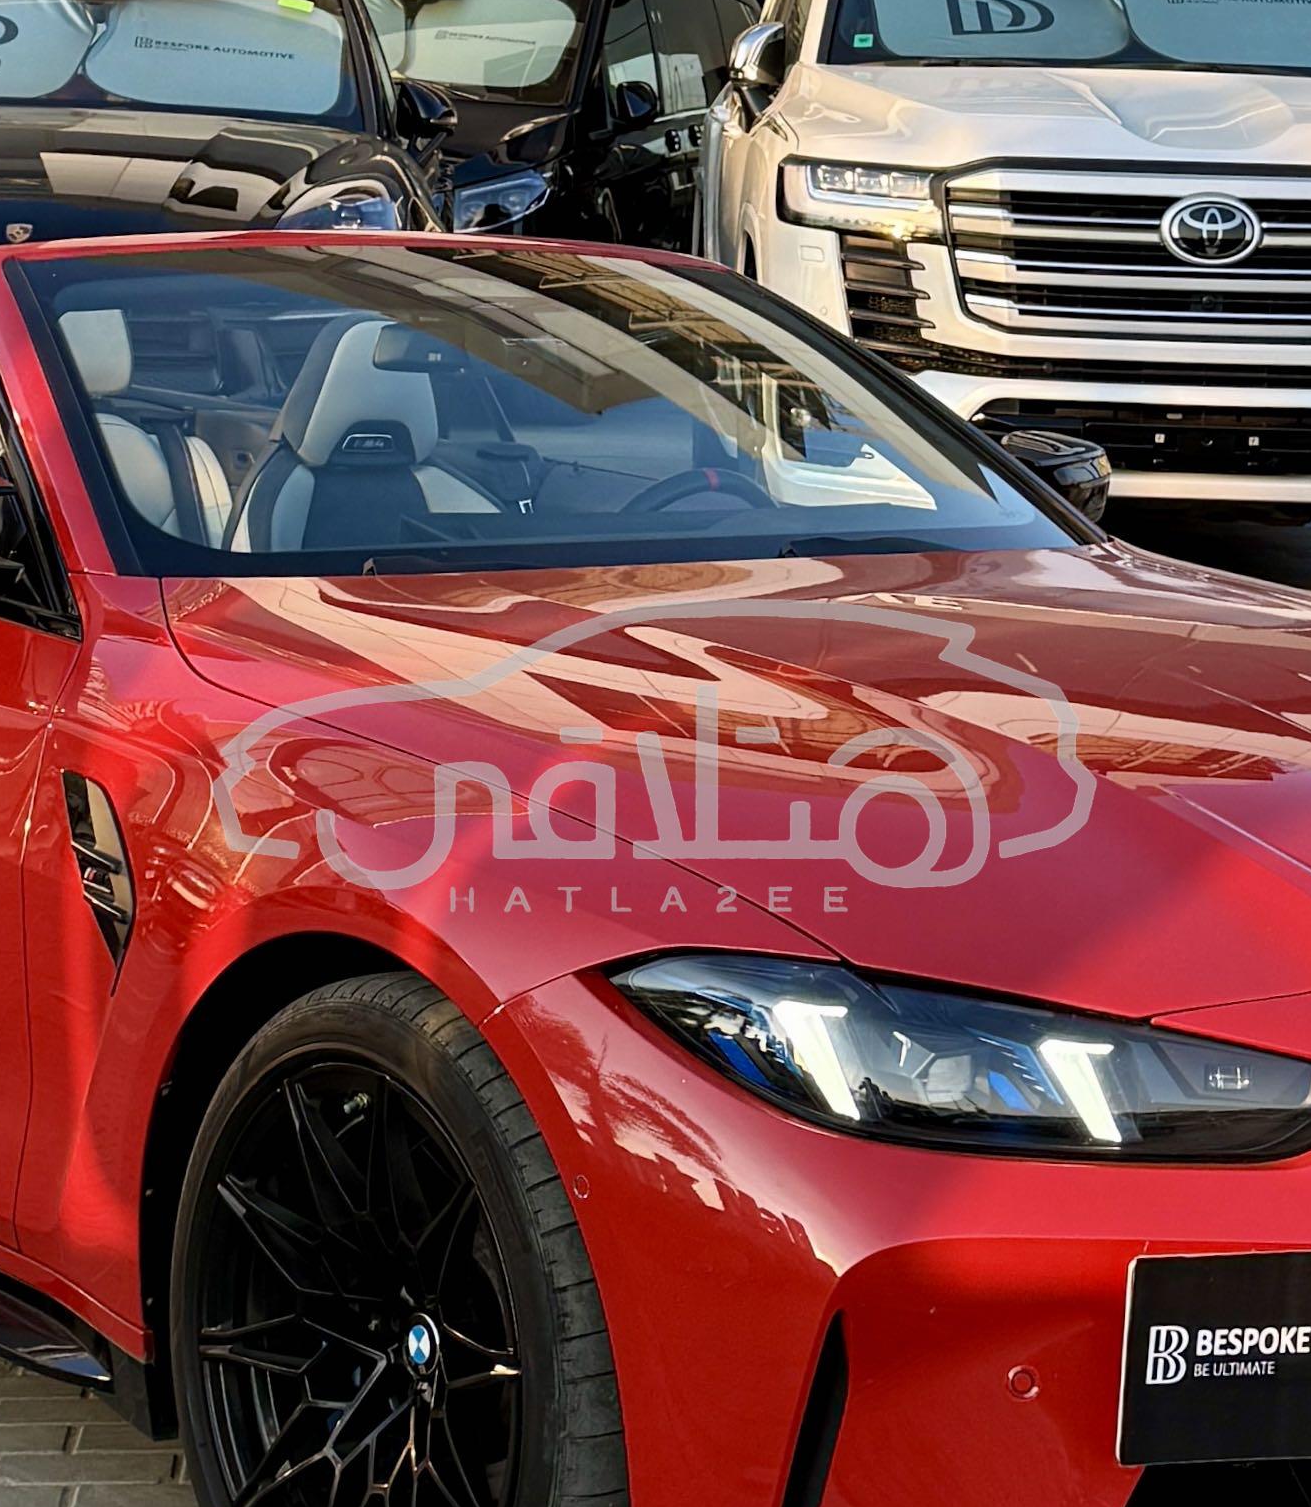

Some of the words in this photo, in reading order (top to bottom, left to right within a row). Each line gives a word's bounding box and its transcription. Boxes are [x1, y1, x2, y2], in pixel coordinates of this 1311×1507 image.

[213, 46, 295, 60] AUTOMOTIVE
[1196, 1325, 1311, 1356] BESPOKE
[1194, 1362, 1210, 1378] BE
[1213, 1360, 1276, 1377] ULTIMATE
